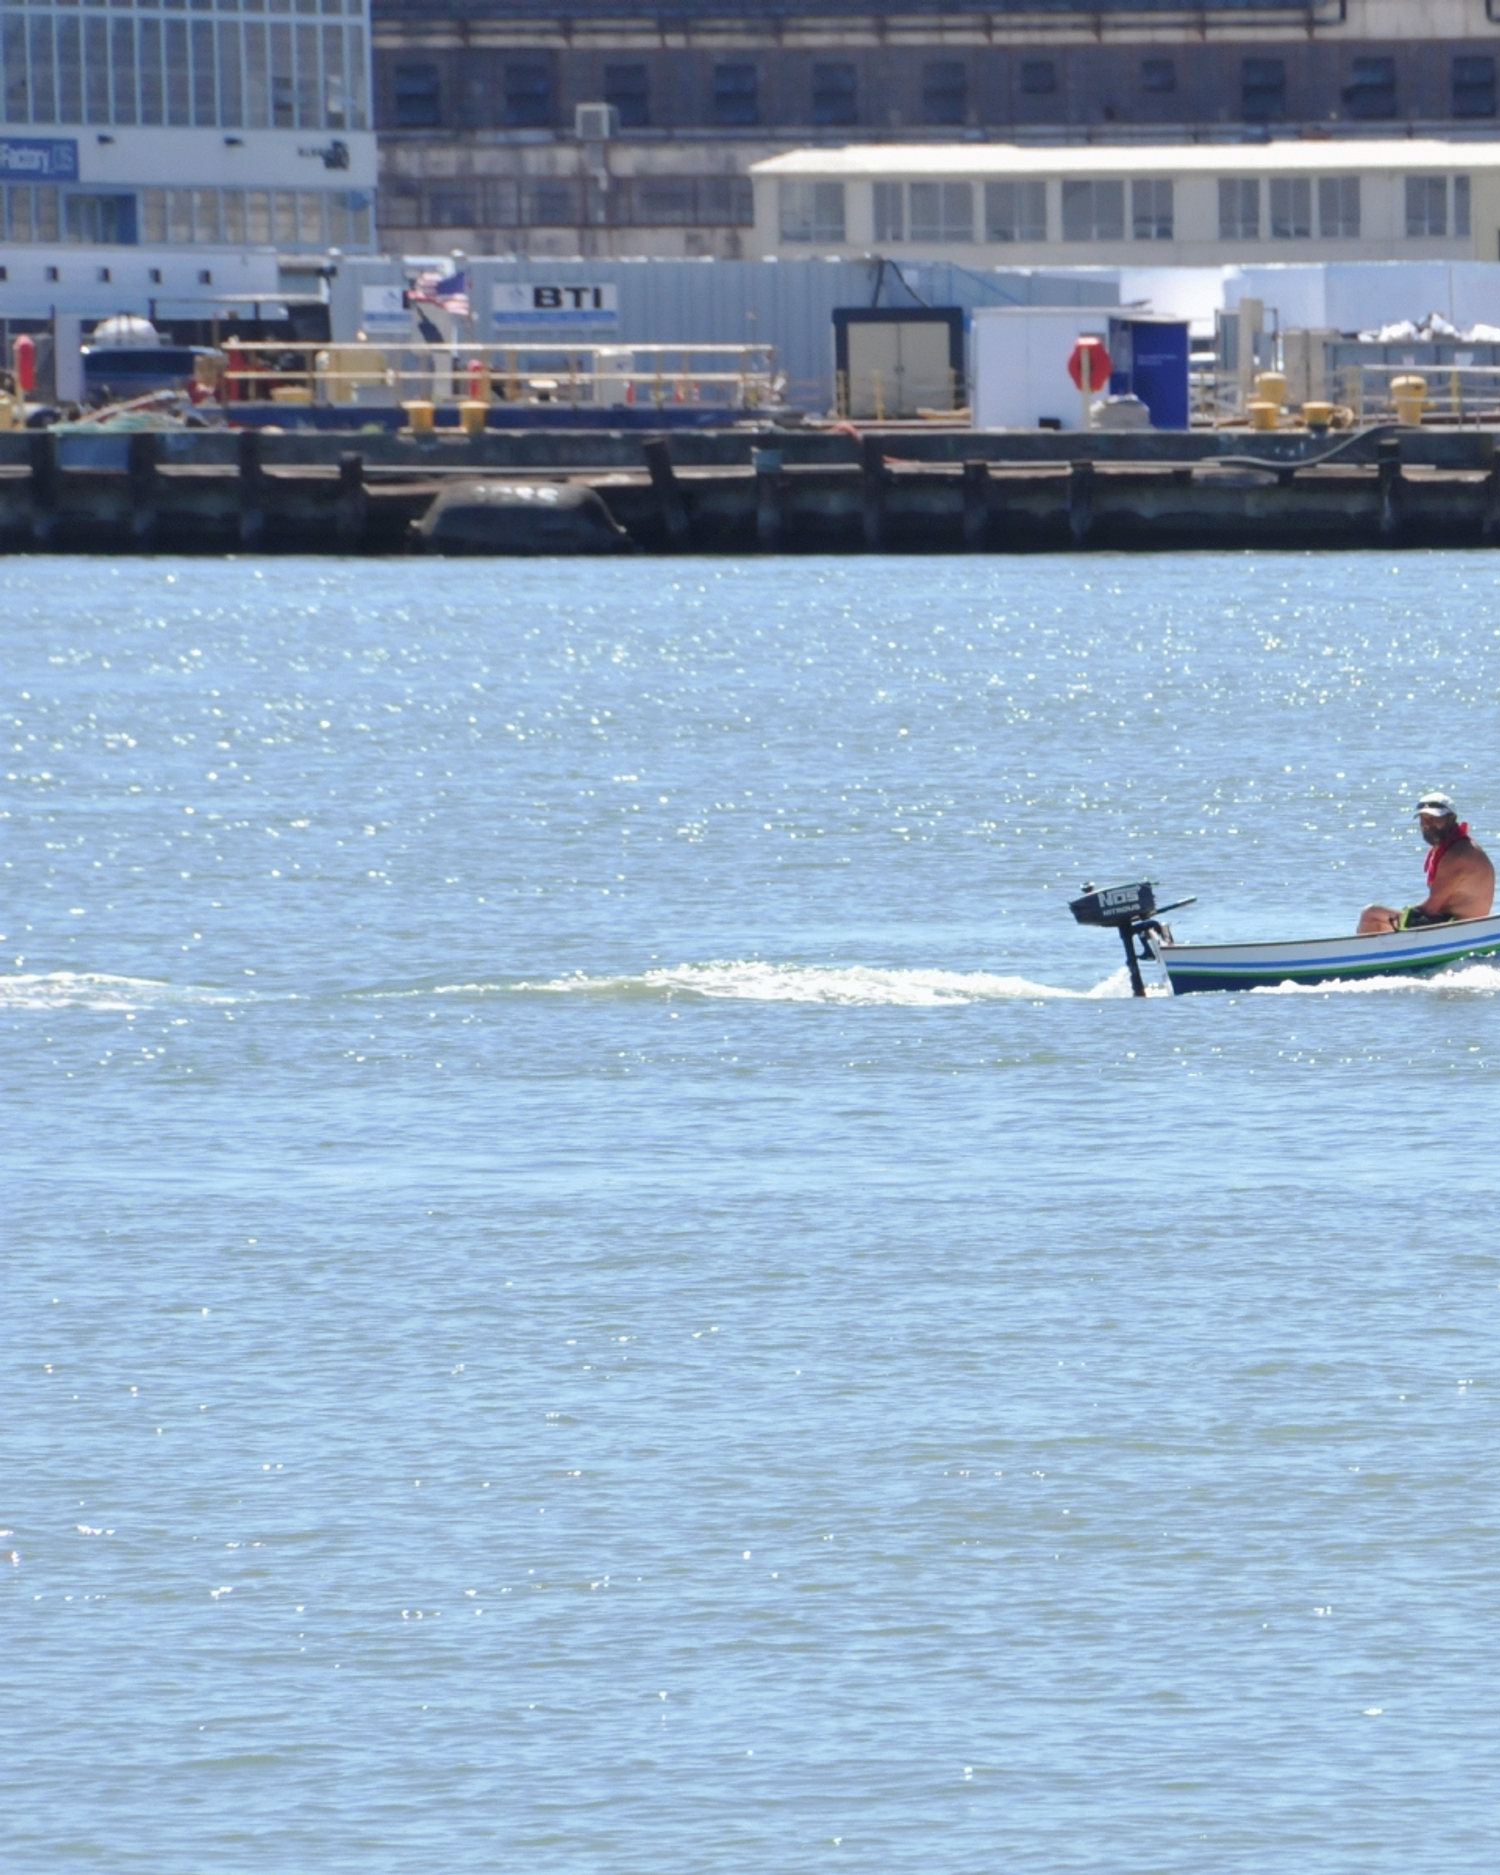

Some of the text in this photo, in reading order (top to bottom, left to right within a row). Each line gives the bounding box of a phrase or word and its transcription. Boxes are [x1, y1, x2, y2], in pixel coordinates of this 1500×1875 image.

[533, 286, 603, 309] BTI
[1097, 885, 1141, 908] NOS
[1103, 903, 1141, 916] NITROUS
